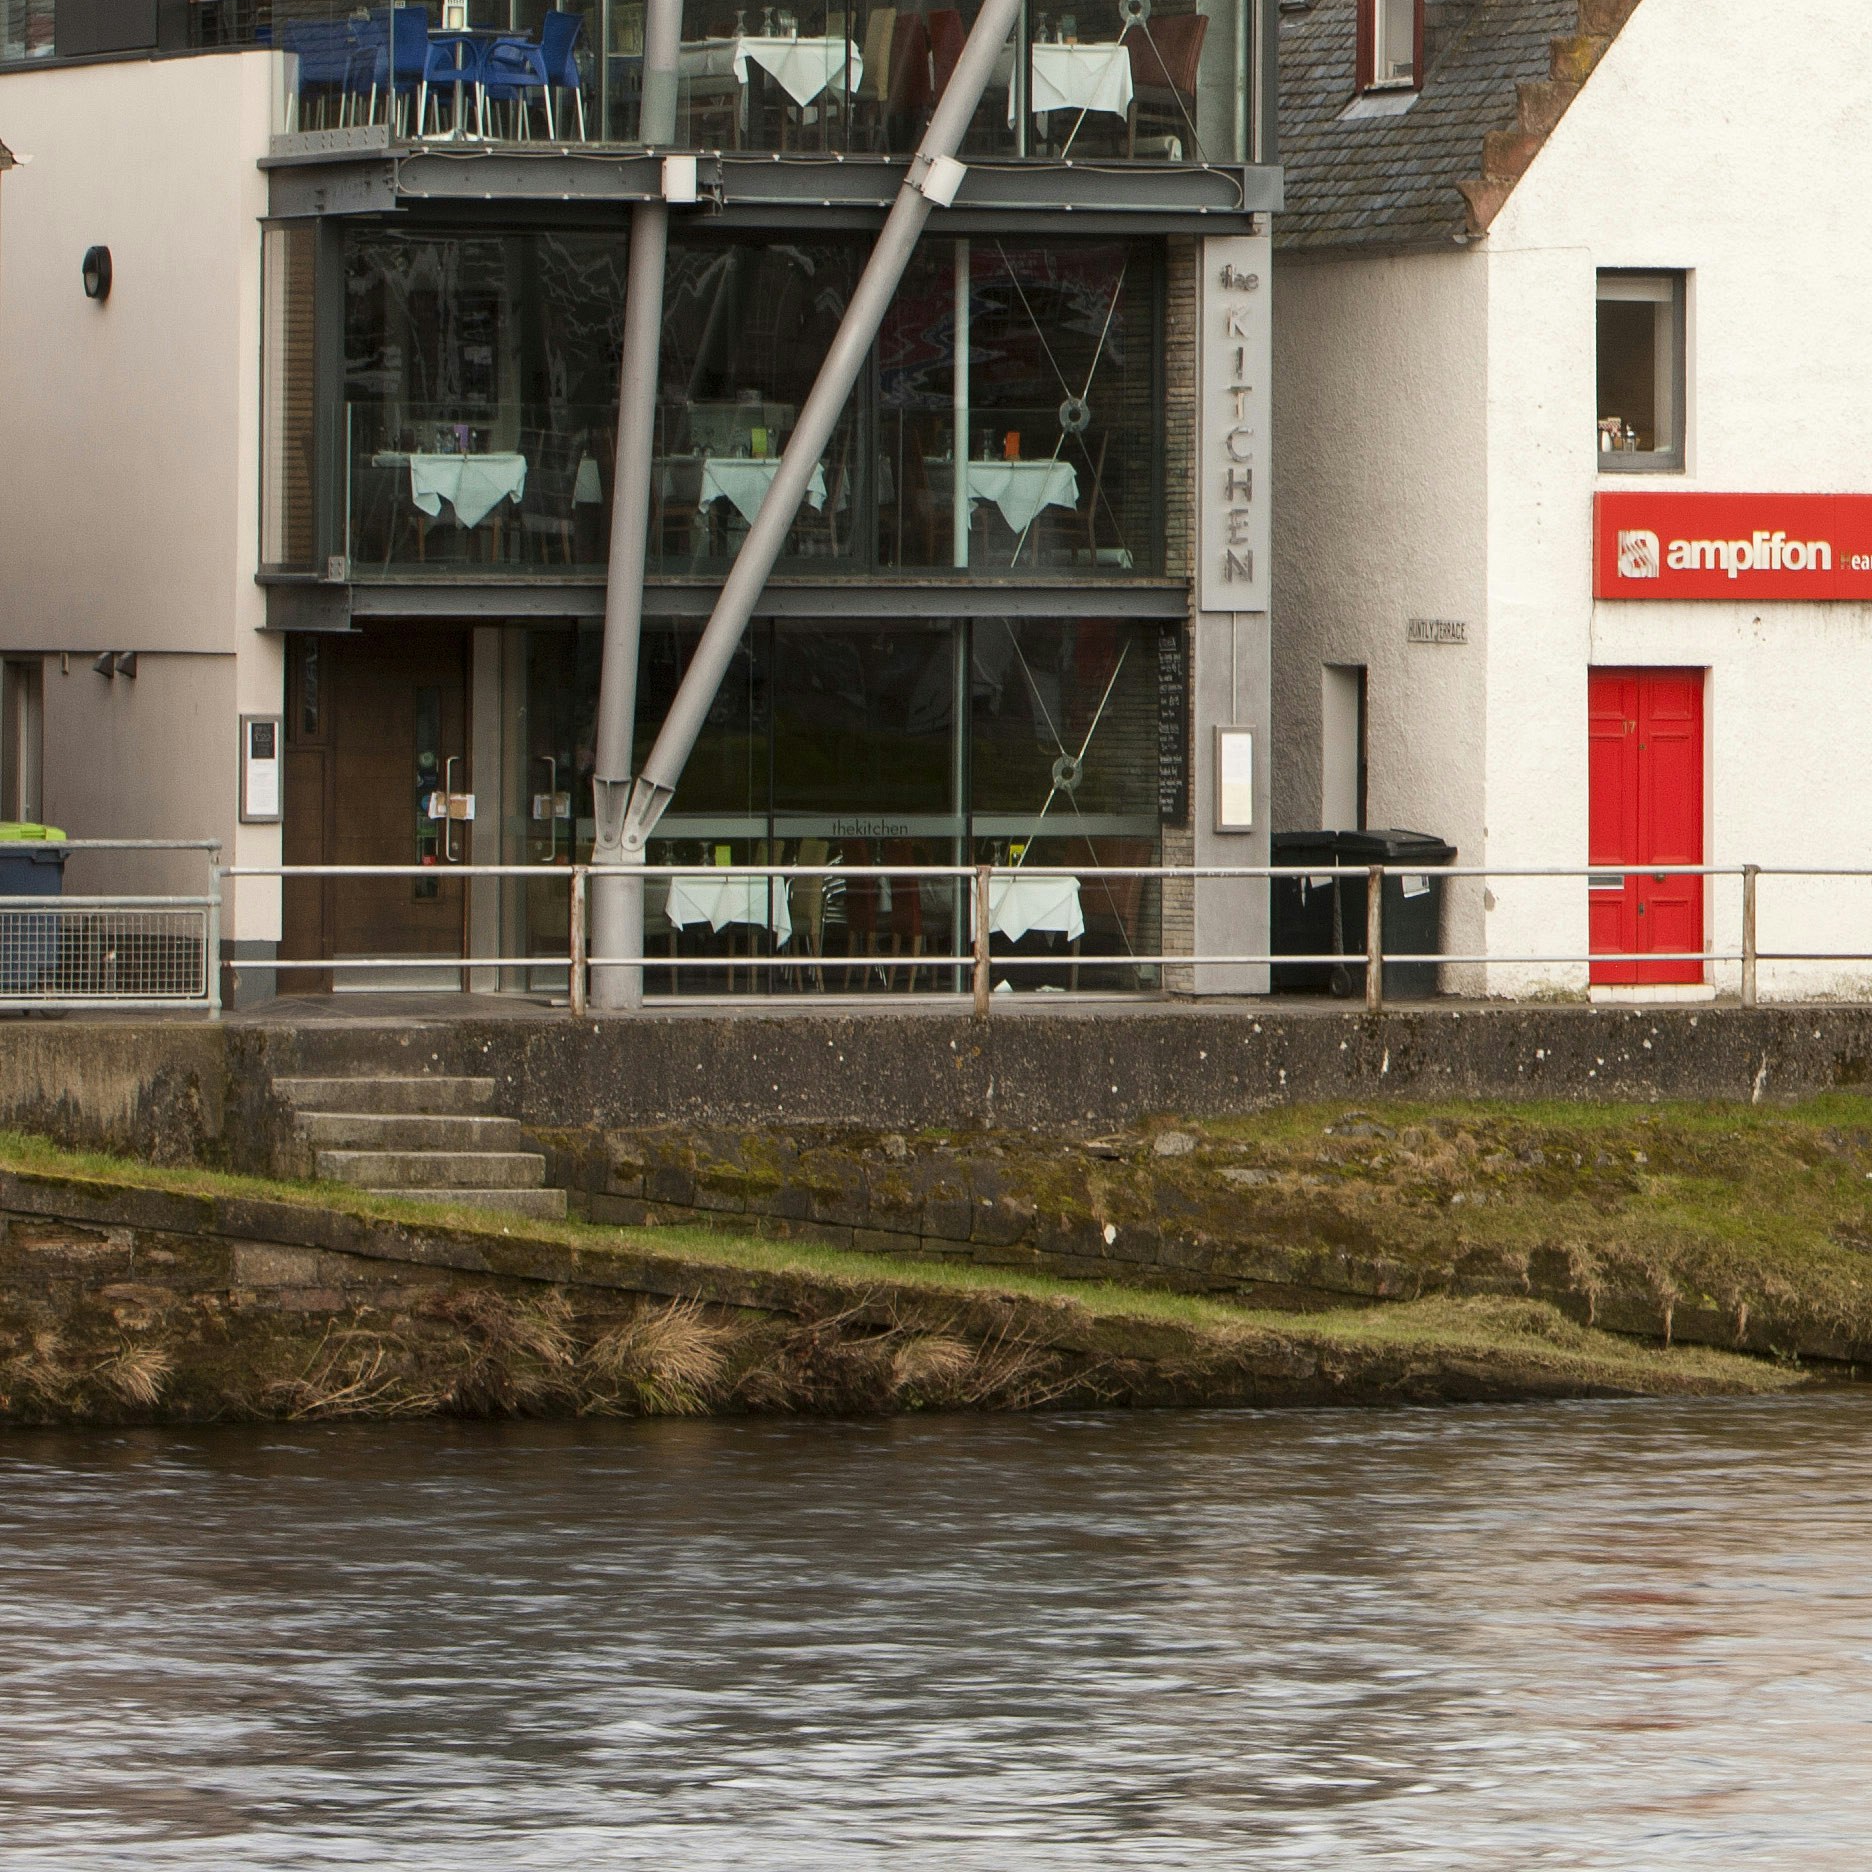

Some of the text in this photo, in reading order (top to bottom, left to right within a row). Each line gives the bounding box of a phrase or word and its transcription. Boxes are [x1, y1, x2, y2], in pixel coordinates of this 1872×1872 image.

[1220, 264, 1259, 291] the
[1225, 304, 1254, 583] KITCHEN
[1667, 531, 1832, 578] amplifon
[1622, 720, 1636, 735] 17
[833, 818, 908, 836] thekitchen
